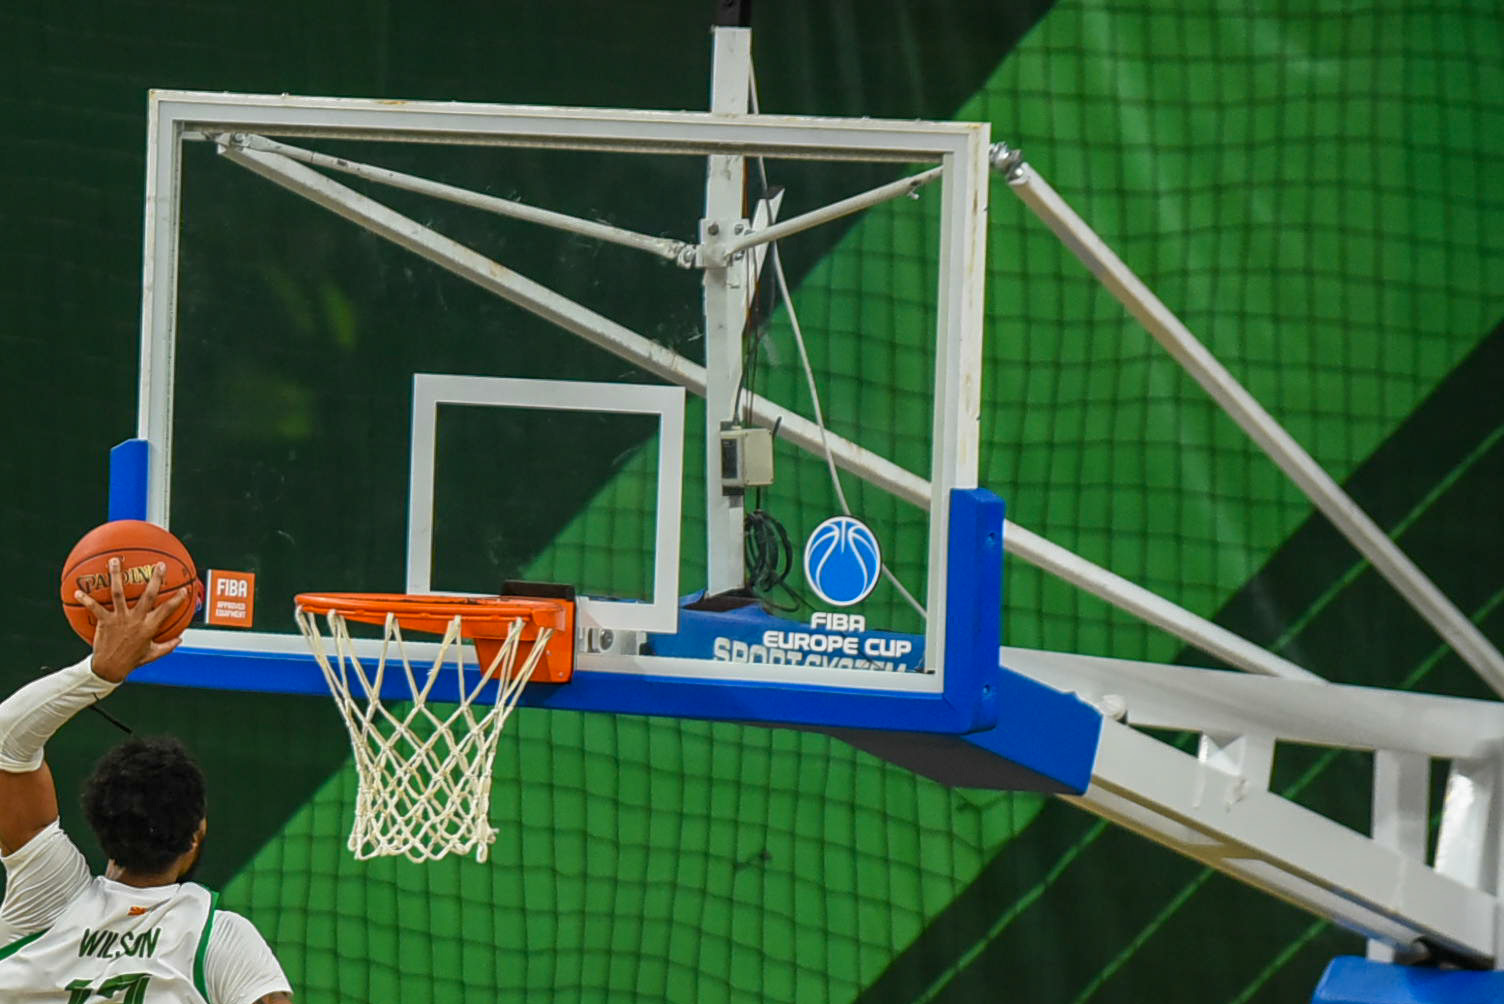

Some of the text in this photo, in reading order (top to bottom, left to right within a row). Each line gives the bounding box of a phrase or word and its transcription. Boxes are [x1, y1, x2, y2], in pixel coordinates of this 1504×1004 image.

[217, 578, 247, 598] FIBA
[811, 612, 866, 632] FIBA
[763, 630, 912, 657] EUROPE CUP
